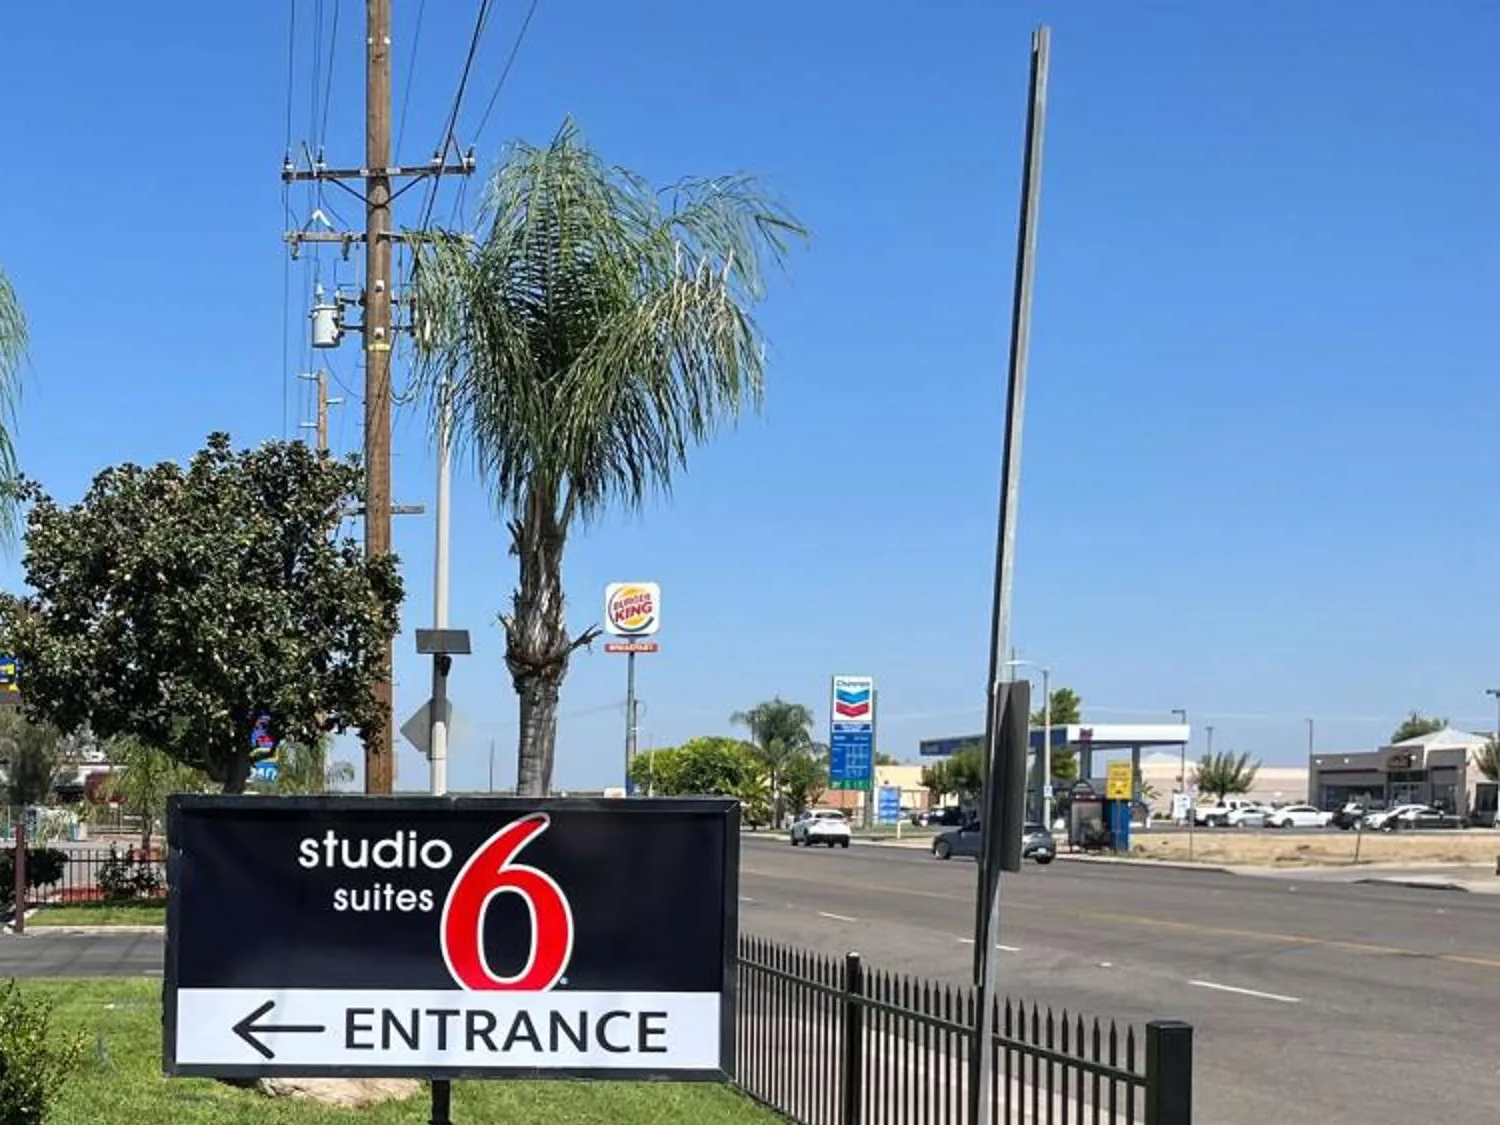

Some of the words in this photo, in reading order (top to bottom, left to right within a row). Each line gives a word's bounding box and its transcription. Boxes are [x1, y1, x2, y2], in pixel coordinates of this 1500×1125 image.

[615, 602, 652, 622] KING
[298, 830, 453, 869] studio
[333, 883, 434, 912] suites
[440, 811, 575, 993] 6
[345, 1008, 669, 1053] ENTRANCE
